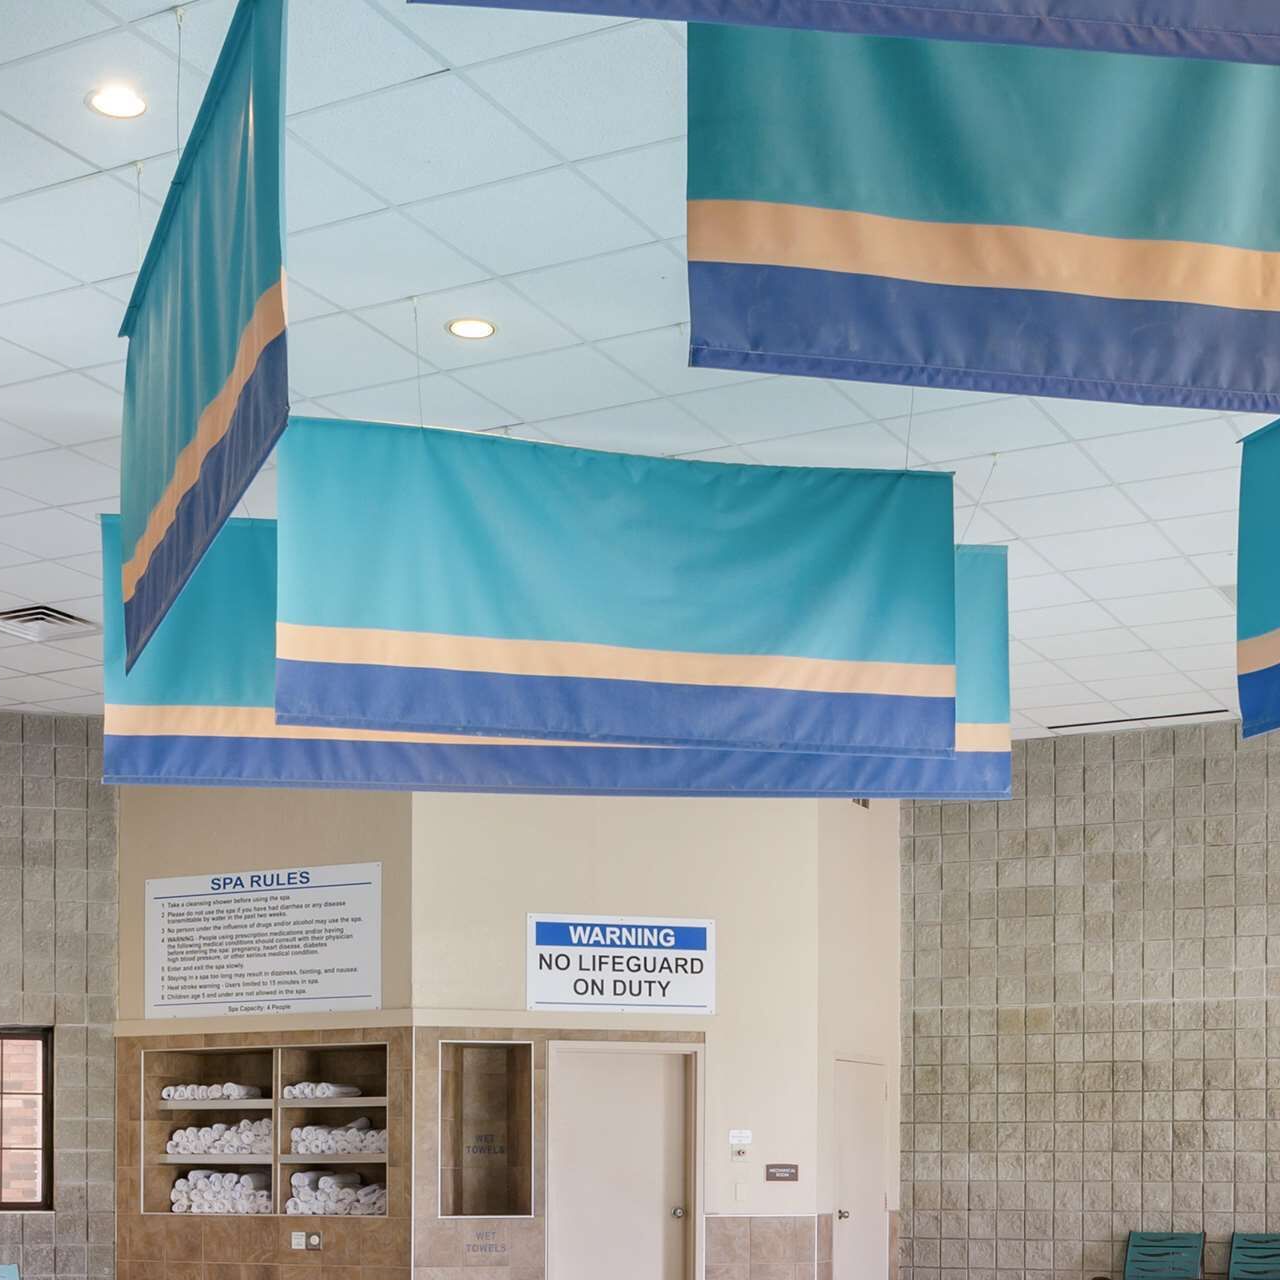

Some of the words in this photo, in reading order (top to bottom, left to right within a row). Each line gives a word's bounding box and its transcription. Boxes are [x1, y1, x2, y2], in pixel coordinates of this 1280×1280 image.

[210, 876, 245, 891] SPA
[250, 871, 310, 889] RULES
[569, 925, 676, 947] WARNING
[539, 953, 571, 971] NO
[578, 954, 704, 974] LIFEGUARD
[573, 978, 604, 996] ON
[613, 979, 671, 998] DUTY
[465, 1145, 505, 1154] TOWELS
[475, 1231, 496, 1241] WET
[465, 1244, 506, 1253] TOWELS
